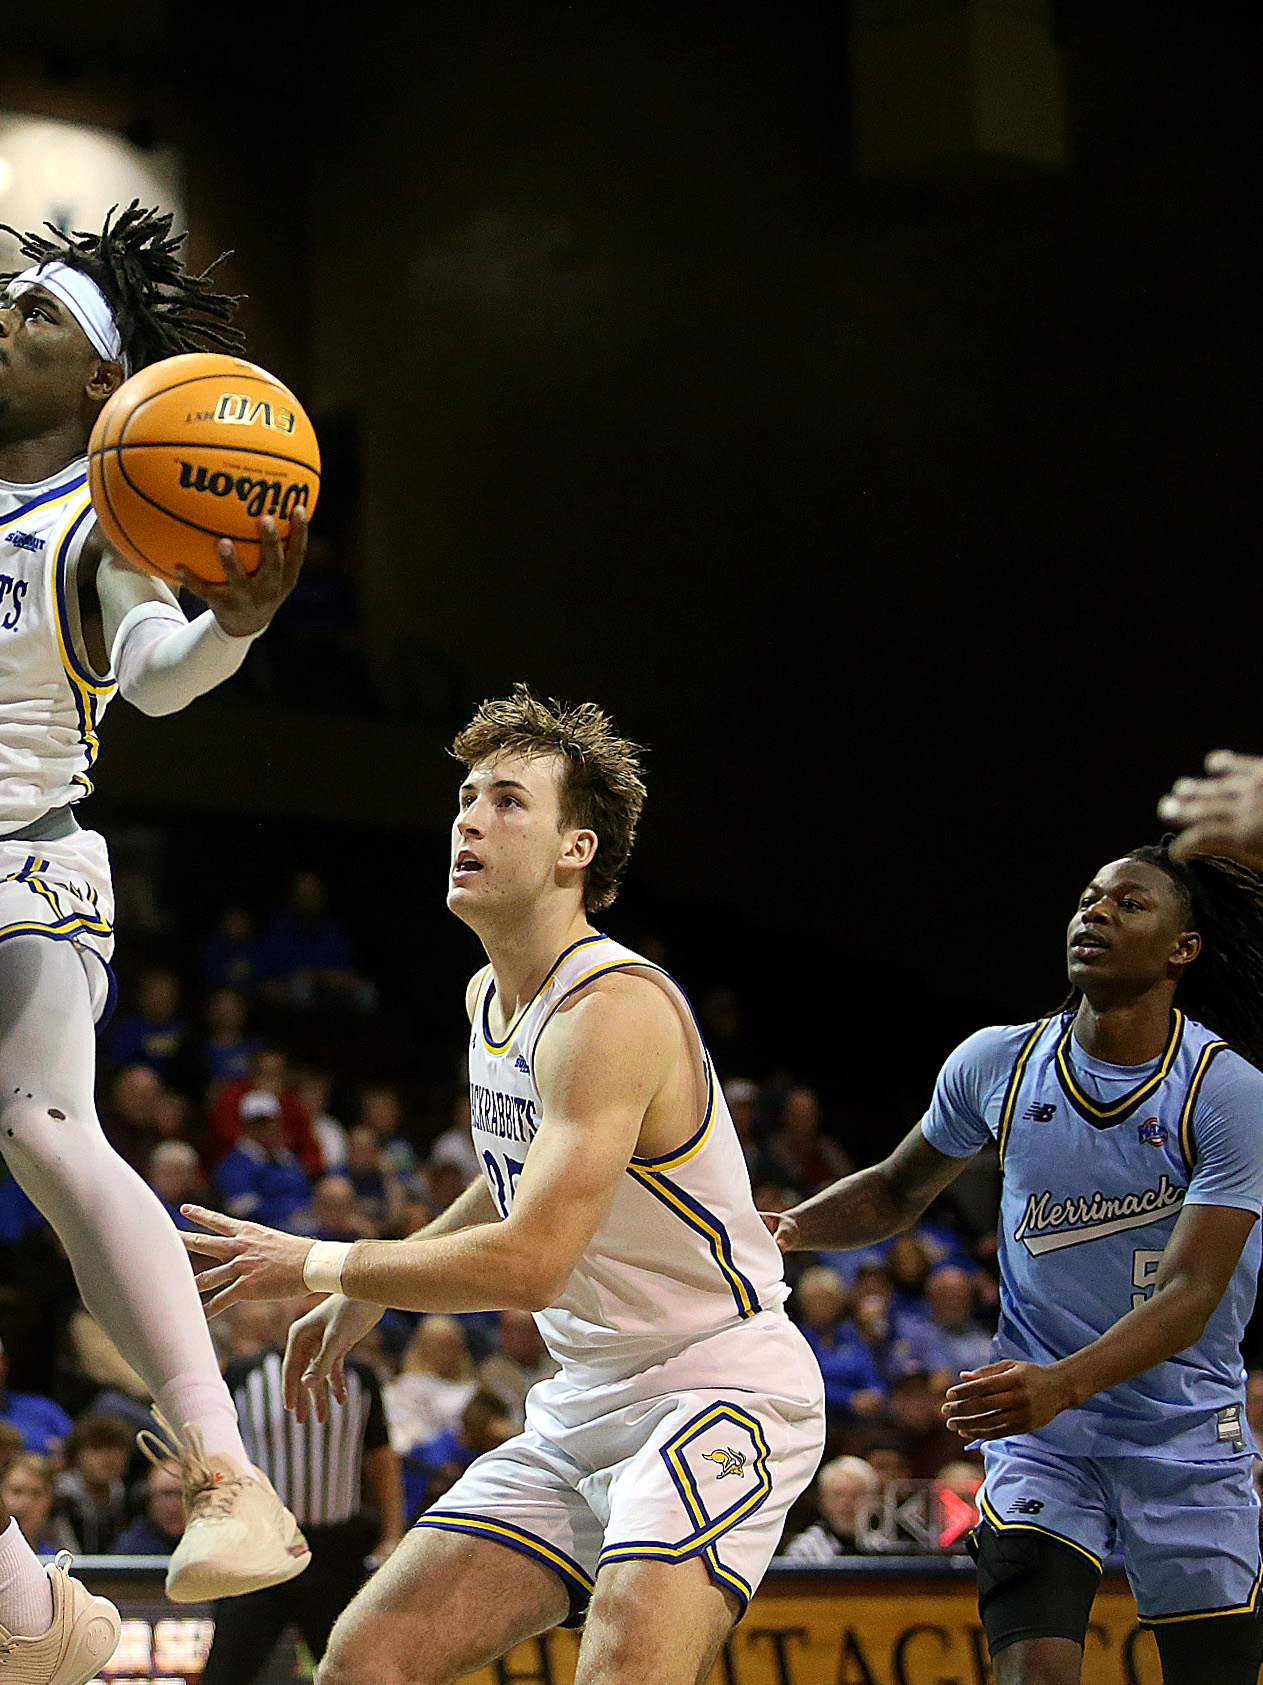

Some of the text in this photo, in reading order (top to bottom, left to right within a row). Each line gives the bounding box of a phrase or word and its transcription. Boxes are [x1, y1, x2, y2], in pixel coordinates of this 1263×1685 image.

[214, 393, 296, 434] EVO
[179, 460, 310, 521] Wilson
[471, 1083, 537, 1144] ACKRABBITS
[1014, 1174, 1180, 1242] Merrimack
[1130, 1249, 1166, 1310] 5
